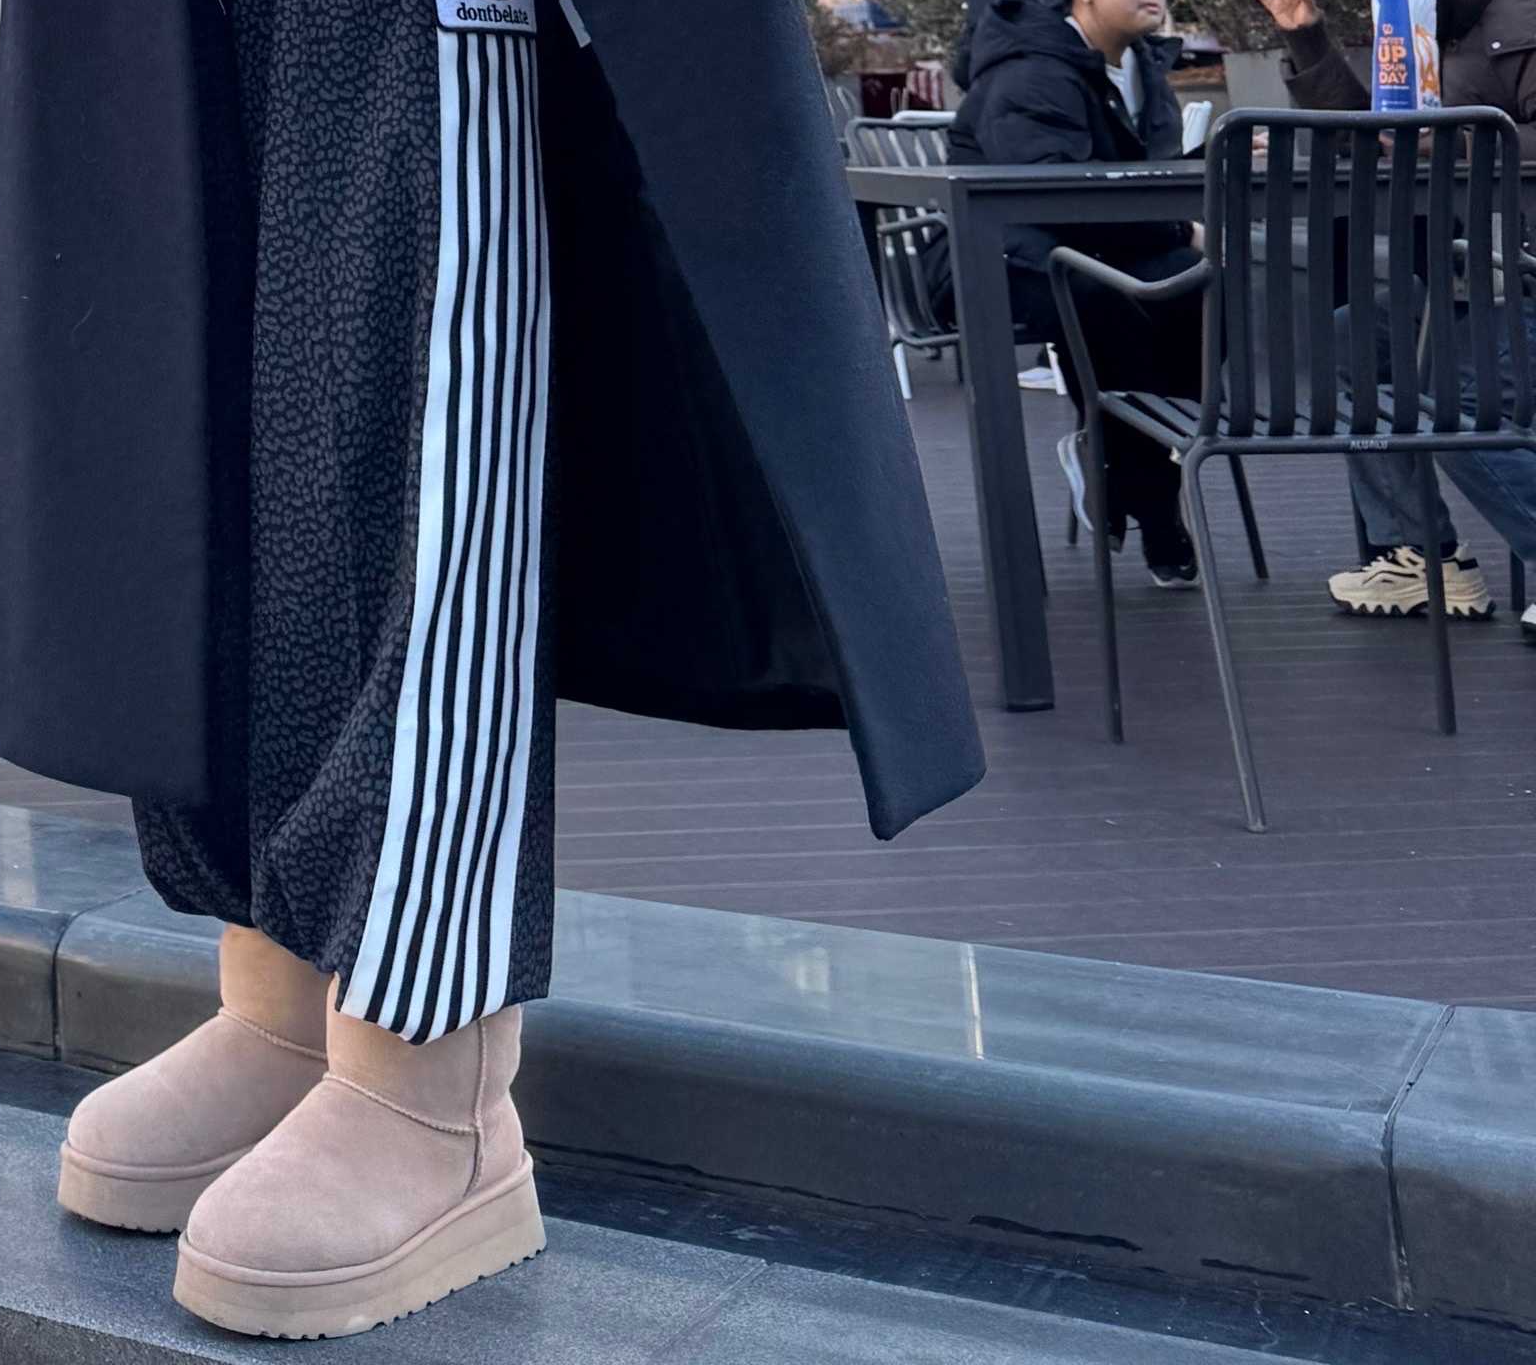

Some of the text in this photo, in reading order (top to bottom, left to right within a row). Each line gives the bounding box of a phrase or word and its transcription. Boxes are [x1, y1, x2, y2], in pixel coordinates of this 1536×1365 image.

[456, 2, 530, 25] dontbelate
[1377, 45, 1407, 63] UP
[1378, 71, 1409, 85] DAY
